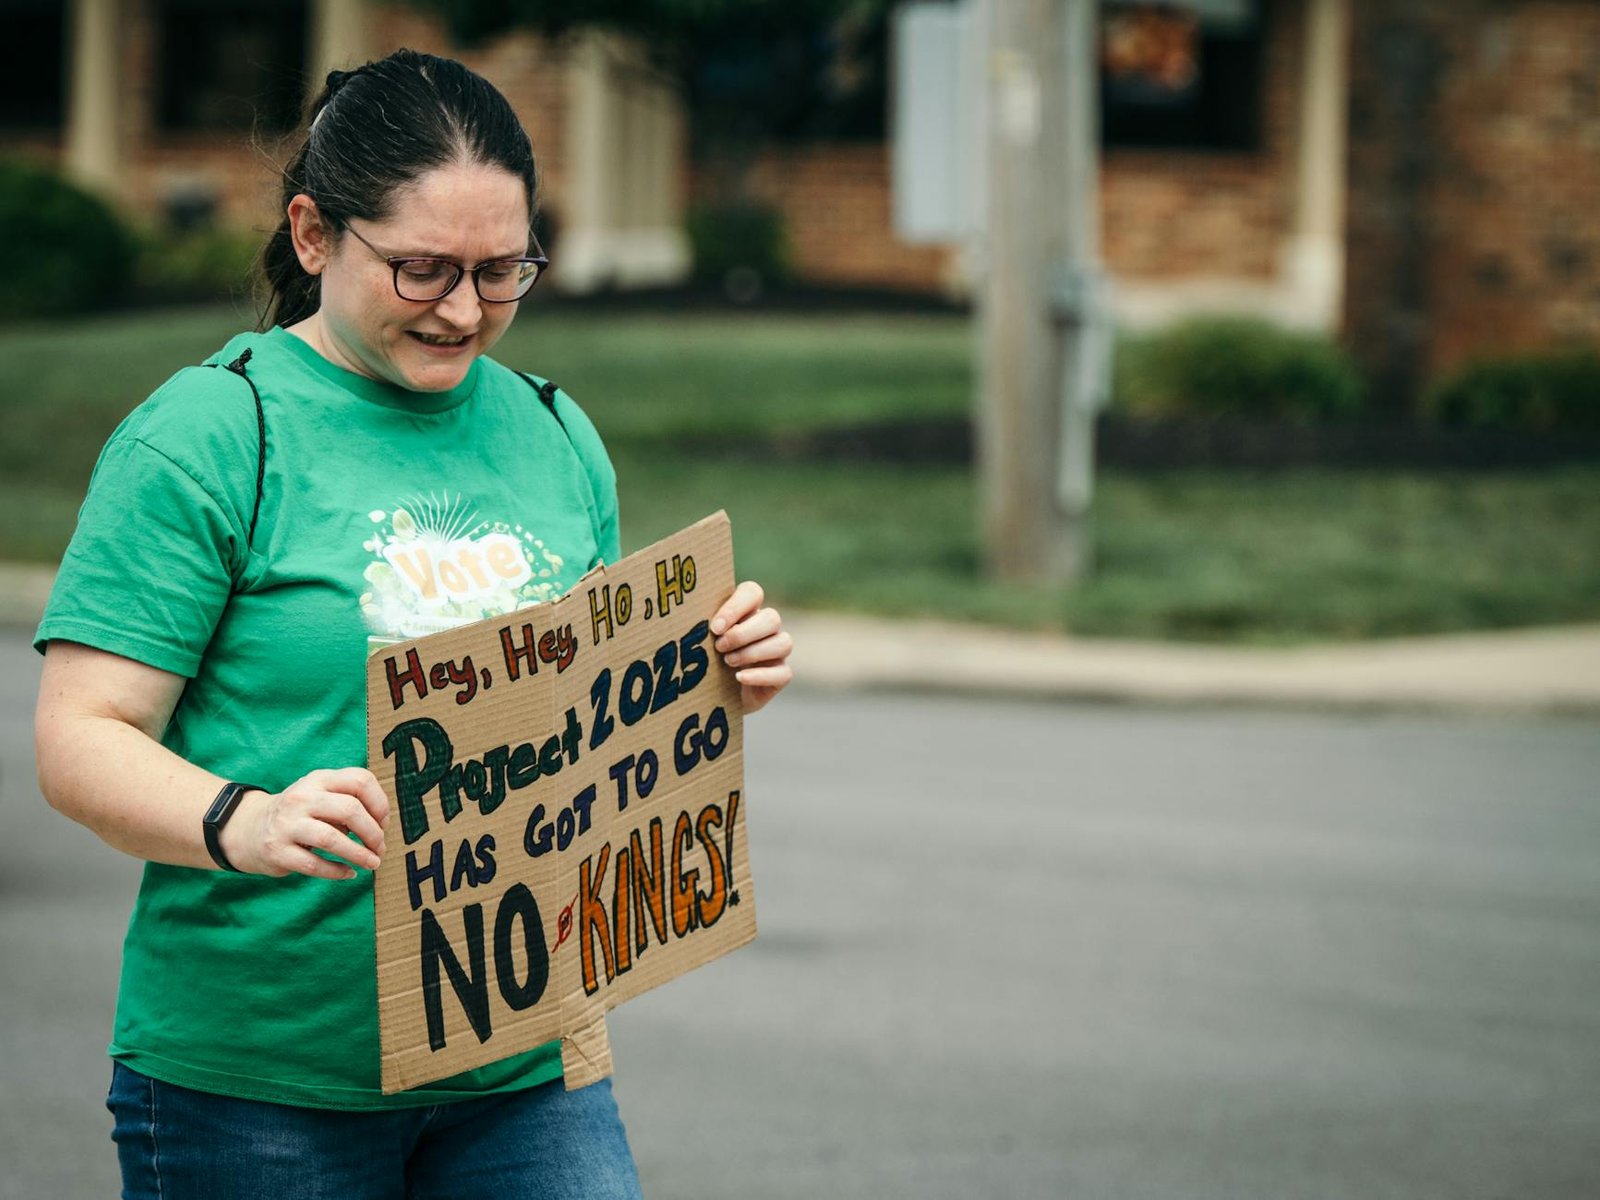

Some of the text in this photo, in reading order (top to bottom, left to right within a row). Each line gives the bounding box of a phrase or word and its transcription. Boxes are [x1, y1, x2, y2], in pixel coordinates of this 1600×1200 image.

[393, 541, 522, 600] Vote
[384, 647, 492, 710] Hey,
[498, 623, 578, 683] Hey
[589, 619, 709, 750] 2025
[405, 706, 729, 911] HAS GOT TO GO
[420, 789, 741, 1052] NO KINGS!
